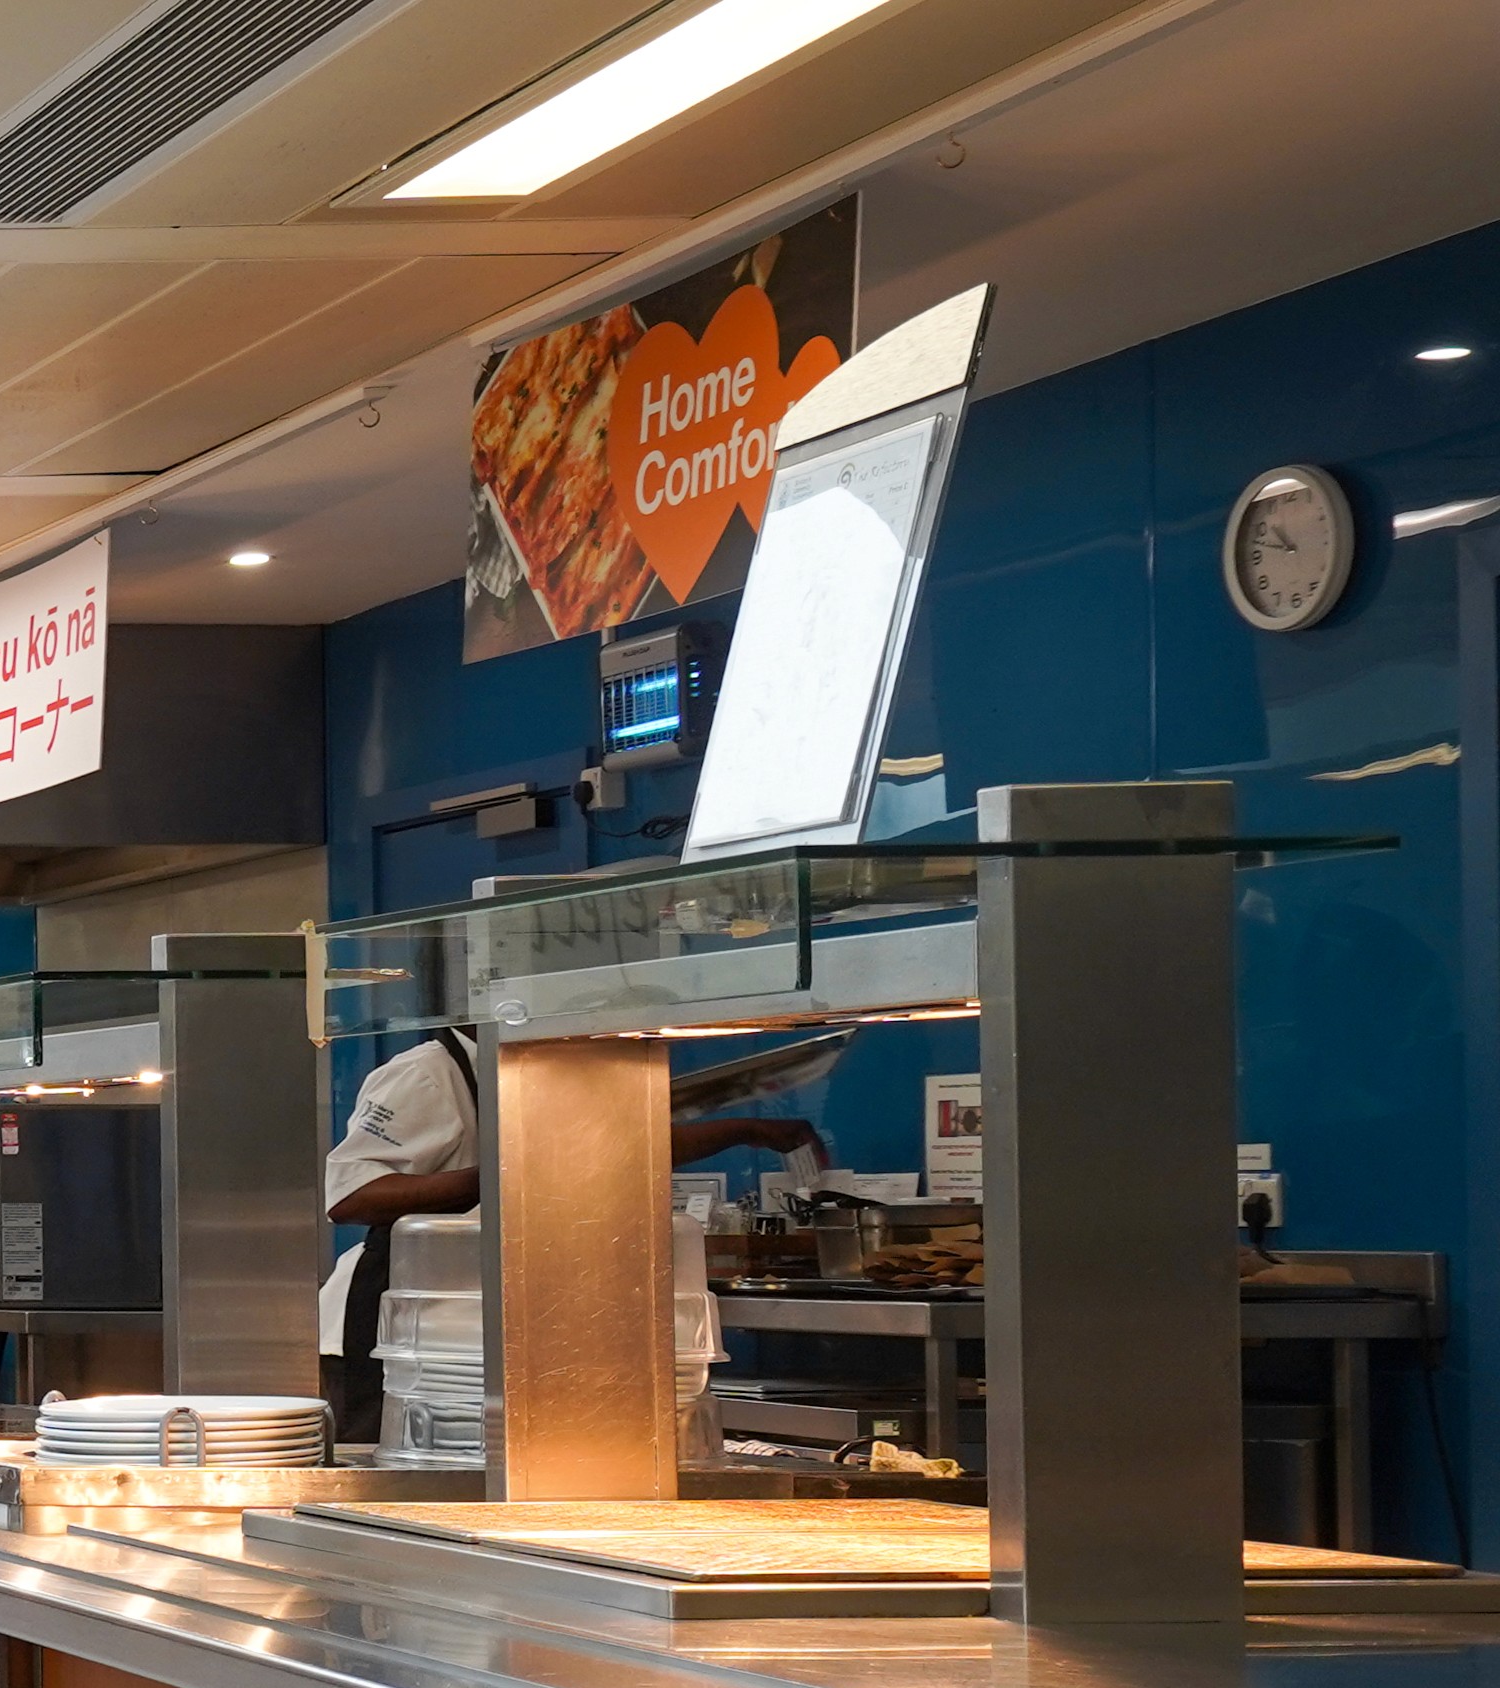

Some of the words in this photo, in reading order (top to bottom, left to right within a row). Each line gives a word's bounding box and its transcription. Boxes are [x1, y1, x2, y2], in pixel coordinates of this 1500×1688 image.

[639, 357, 756, 445] Home
[635, 409, 785, 515] Comfor
[1253, 550, 1262, 566] 9
[1258, 575, 1268, 590] 8
[1272, 591, 1282, 607] 7
[1291, 593, 1302, 608] 6
[27, 605, 58, 674] kō
[66, 586, 96, 657] nā
